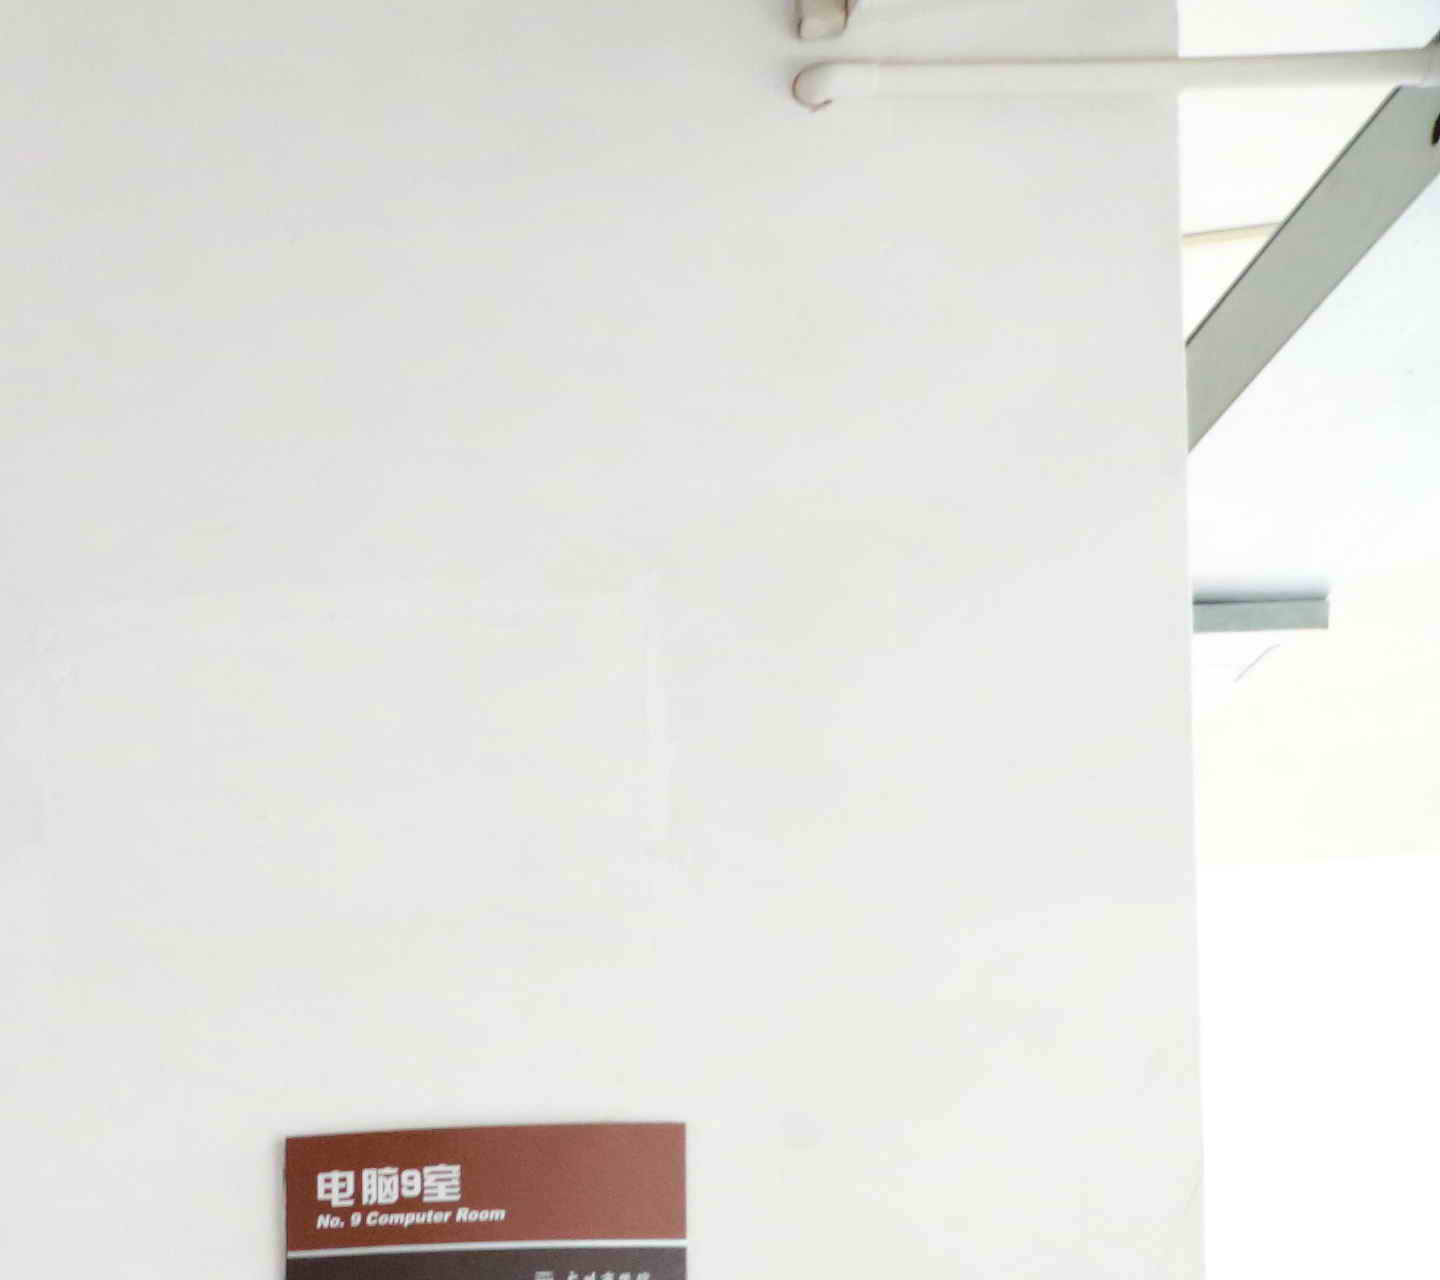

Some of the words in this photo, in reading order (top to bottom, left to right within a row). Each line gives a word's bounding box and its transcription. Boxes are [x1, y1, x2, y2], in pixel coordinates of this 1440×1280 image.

[316, 1163, 461, 1208] 电脑9室
[316, 1213, 345, 1229] No.
[350, 1211, 362, 1227] 9
[366, 1209, 452, 1228] Computer
[456, 1207, 507, 1223] Room
